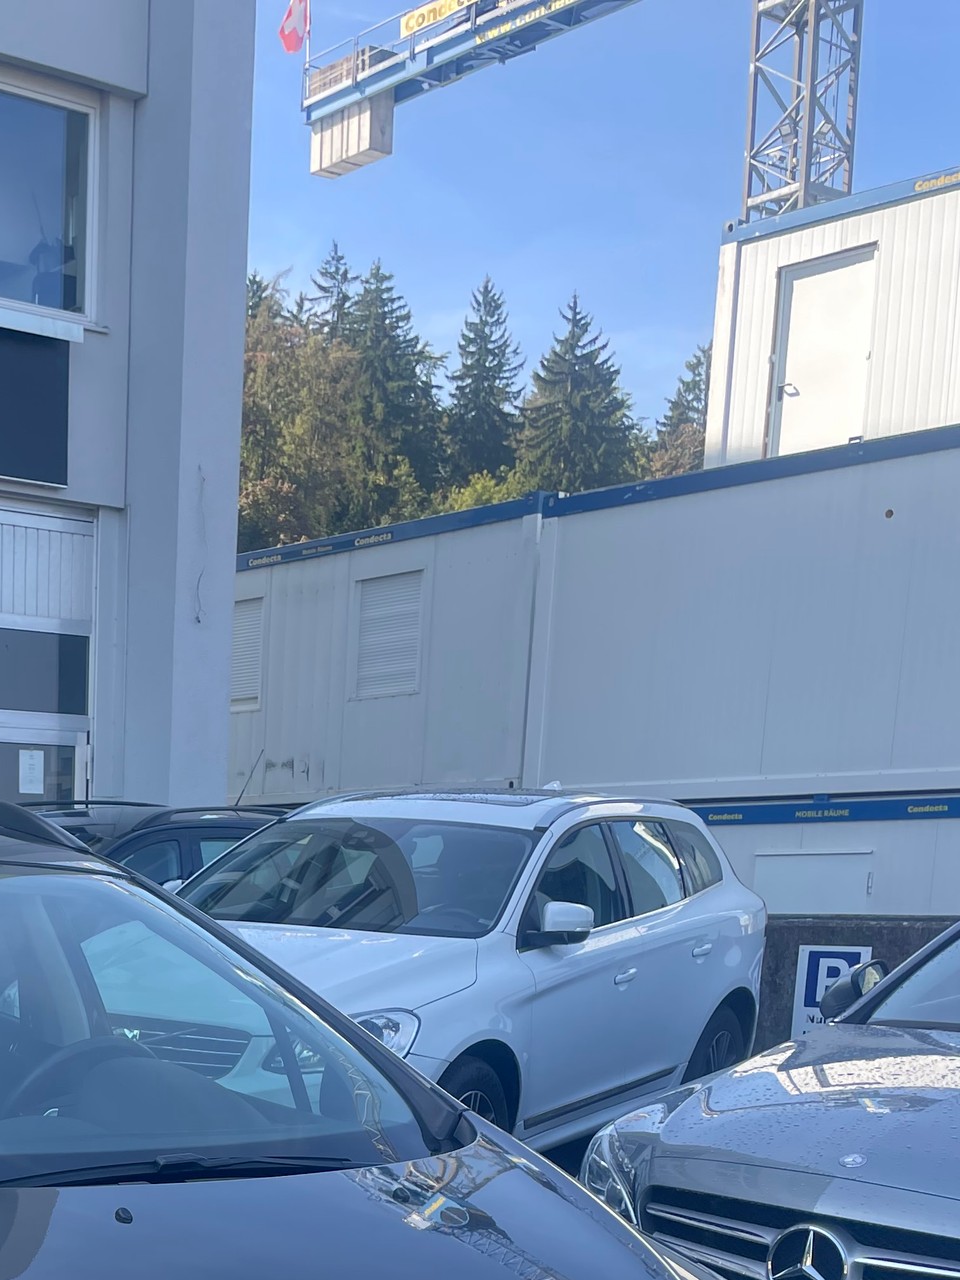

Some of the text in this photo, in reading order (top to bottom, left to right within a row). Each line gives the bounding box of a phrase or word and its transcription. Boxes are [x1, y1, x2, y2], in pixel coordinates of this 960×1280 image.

[354, 532, 392, 546] Condecta
[248, 554, 282, 567] Condecta
[708, 804, 949, 821] Condecta MOBILE RÄUME Condecta
[816, 957, 849, 1002] P
